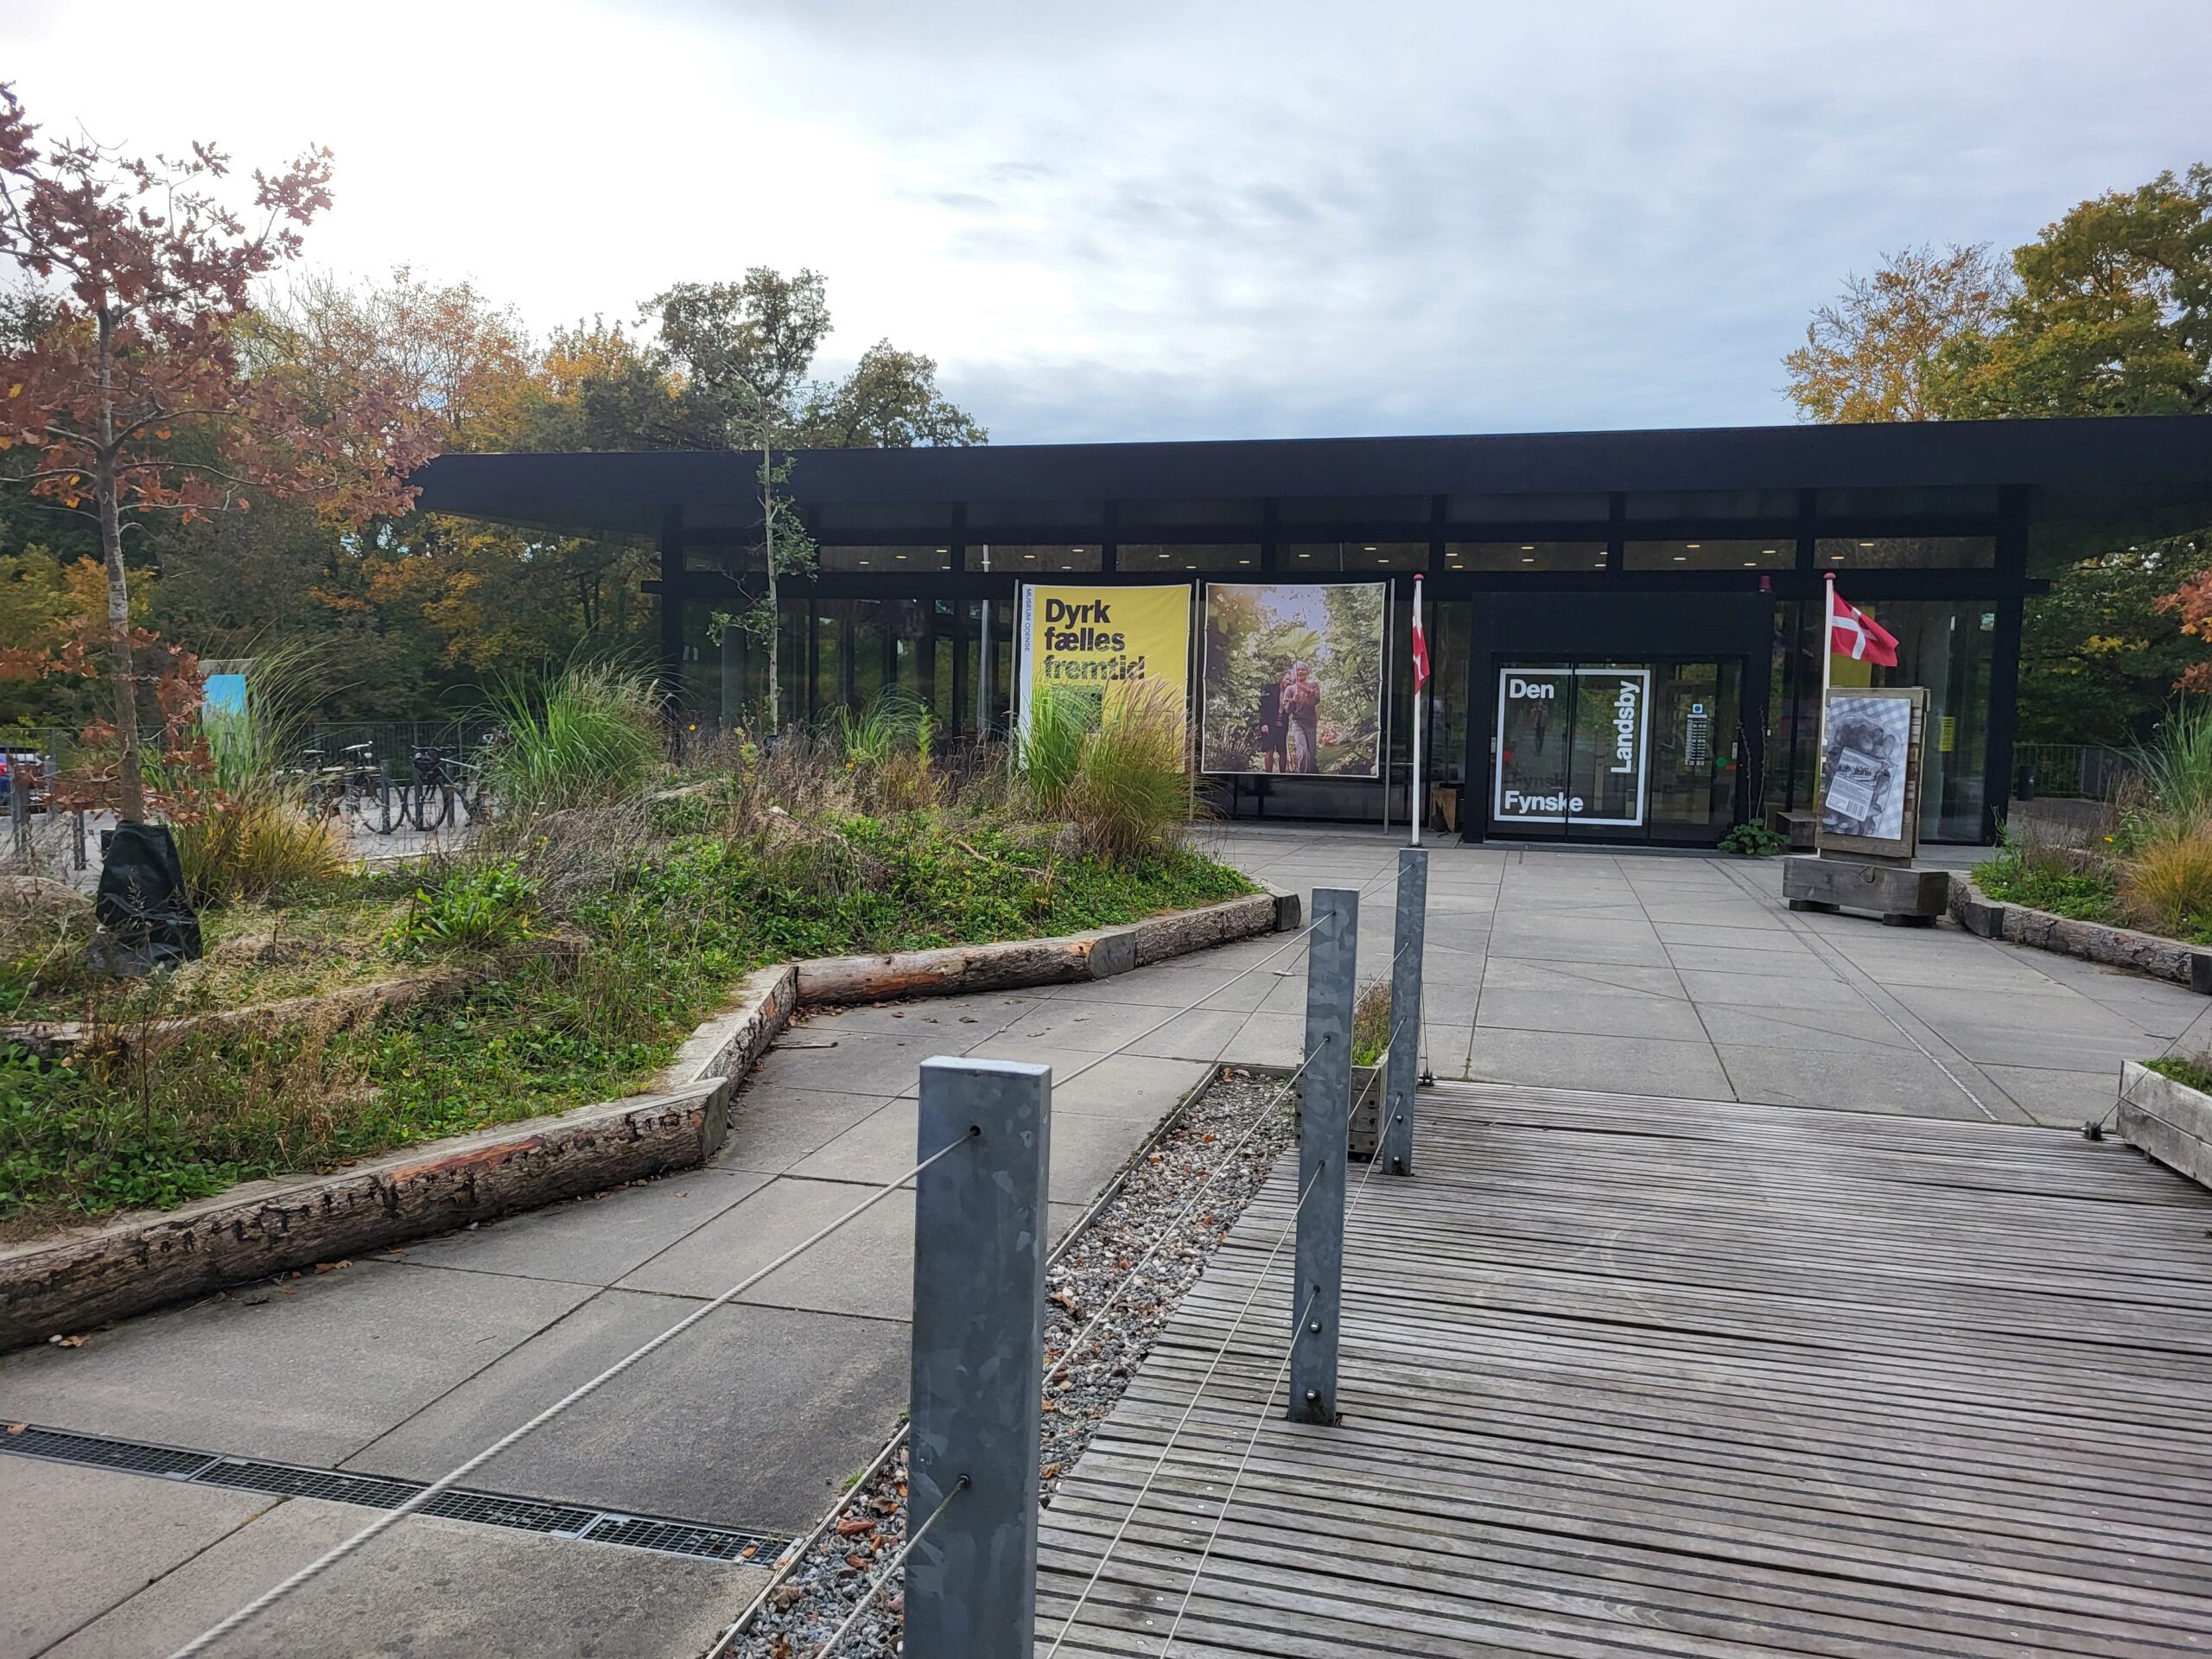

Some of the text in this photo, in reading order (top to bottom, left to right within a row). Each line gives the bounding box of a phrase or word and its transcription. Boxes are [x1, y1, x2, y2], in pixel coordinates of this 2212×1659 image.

[1045, 598, 1111, 630] Dyrk
[1044, 626, 1126, 652] fælles
[1043, 654, 1146, 681] fremtid
[1509, 678, 1554, 699] Den
[1610, 680, 1640, 773] Landsby
[1504, 790, 1584, 815] Fynske
